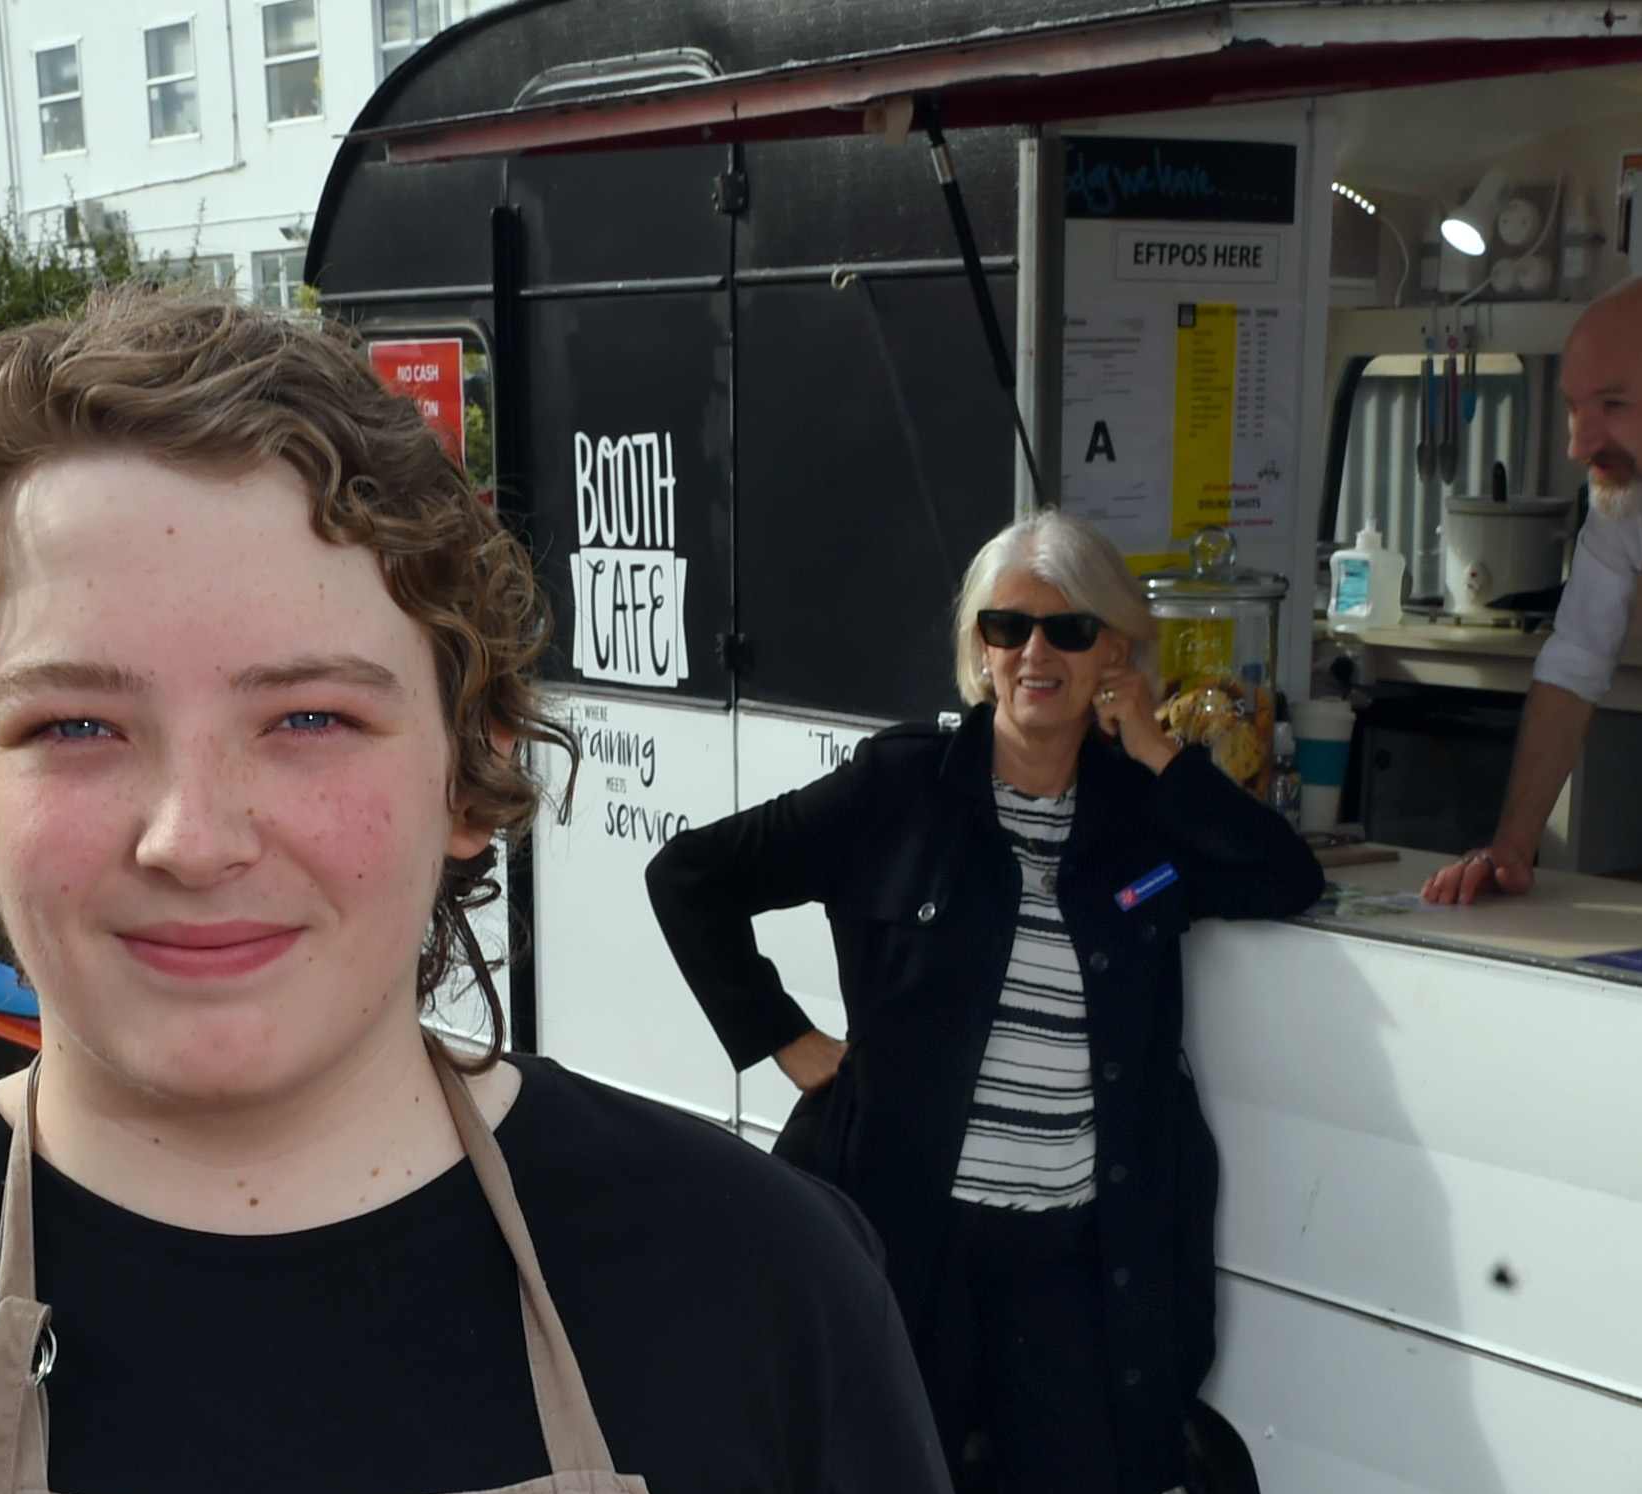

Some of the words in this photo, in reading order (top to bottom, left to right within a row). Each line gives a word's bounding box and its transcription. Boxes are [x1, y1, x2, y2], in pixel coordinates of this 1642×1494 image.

[1133, 241, 1207, 267] EFTPOS
[1212, 244, 1263, 268] HERE
[397, 364, 412, 382] NO
[413, 363, 440, 382] CASH
[423, 401, 440, 417] ON
[1084, 420, 1116, 463] A
[574, 431, 676, 548] BOOTH
[1234, 498, 1261, 510] SHOTS
[587, 558, 670, 676] CAFE
[584, 705, 608, 722] WHERE
[606, 776, 627, 793] MEETS
